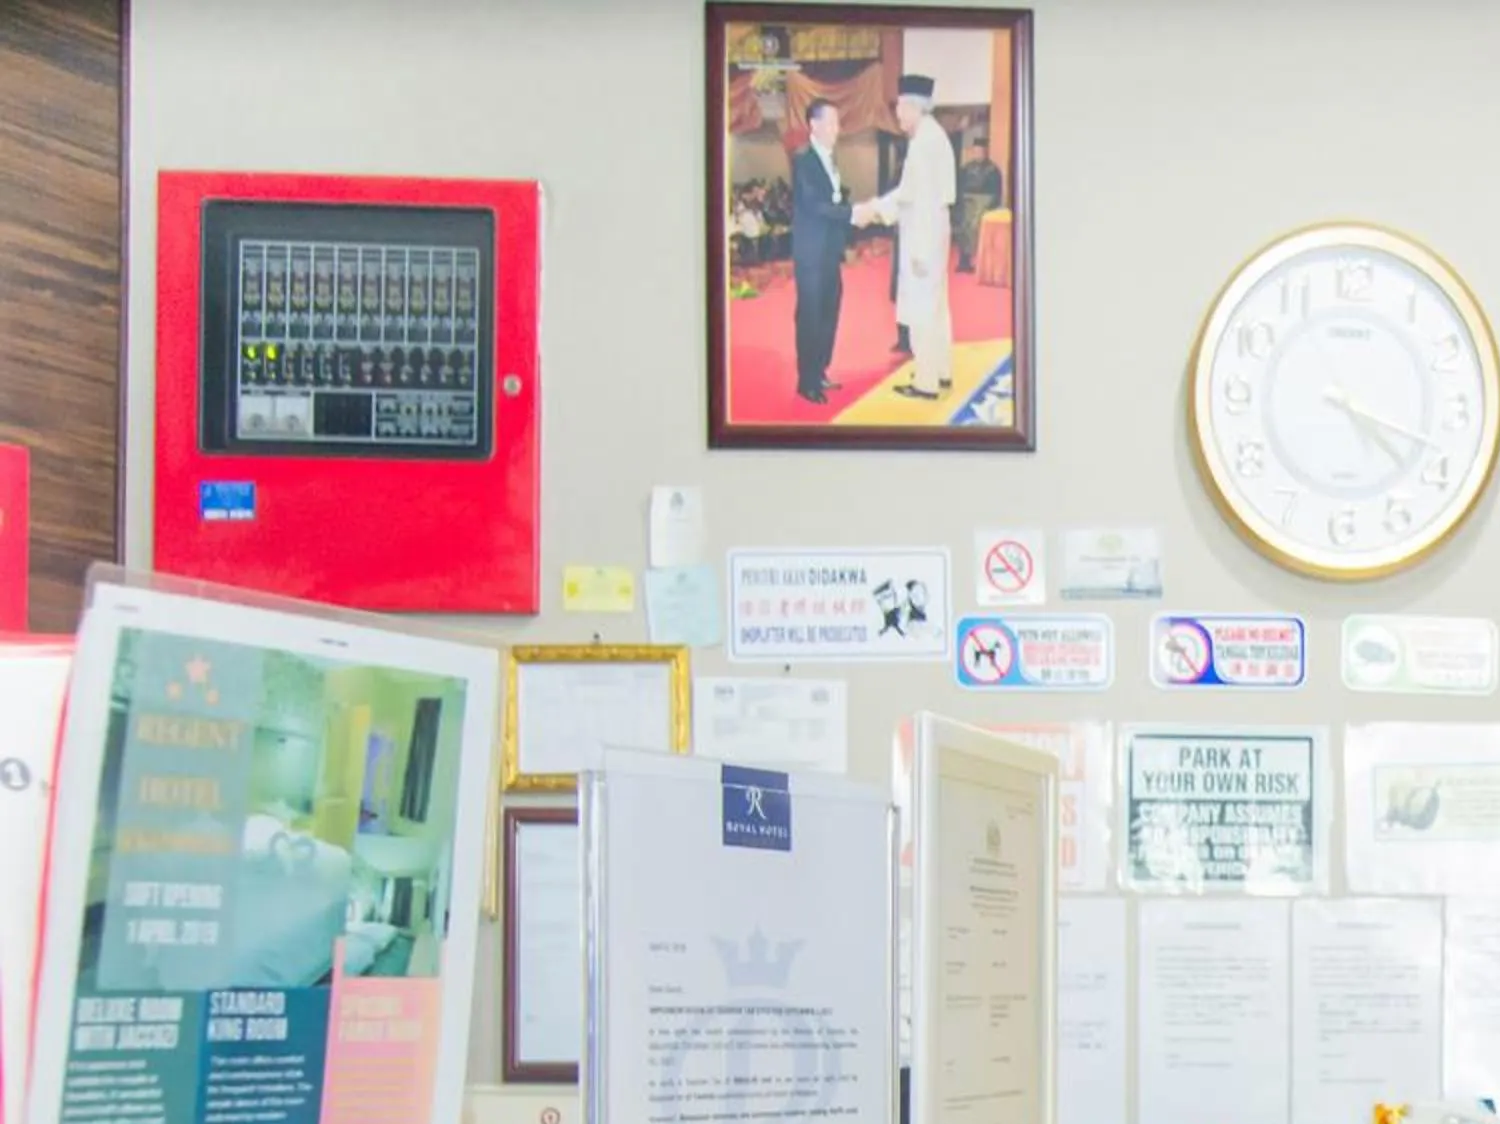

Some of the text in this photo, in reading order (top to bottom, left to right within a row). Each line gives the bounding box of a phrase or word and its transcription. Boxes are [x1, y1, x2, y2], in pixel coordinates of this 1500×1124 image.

[808, 568, 867, 585] DIDAKWA
[135, 713, 246, 753] REGENT
[1179, 746, 1264, 769] PARK AT
[138, 775, 223, 811] HOTEL
[1142, 770, 1300, 794] YOUR OWN RISK
[209, 990, 286, 1016] STANDARD
[206, 1016, 288, 1042] KING ROOM
